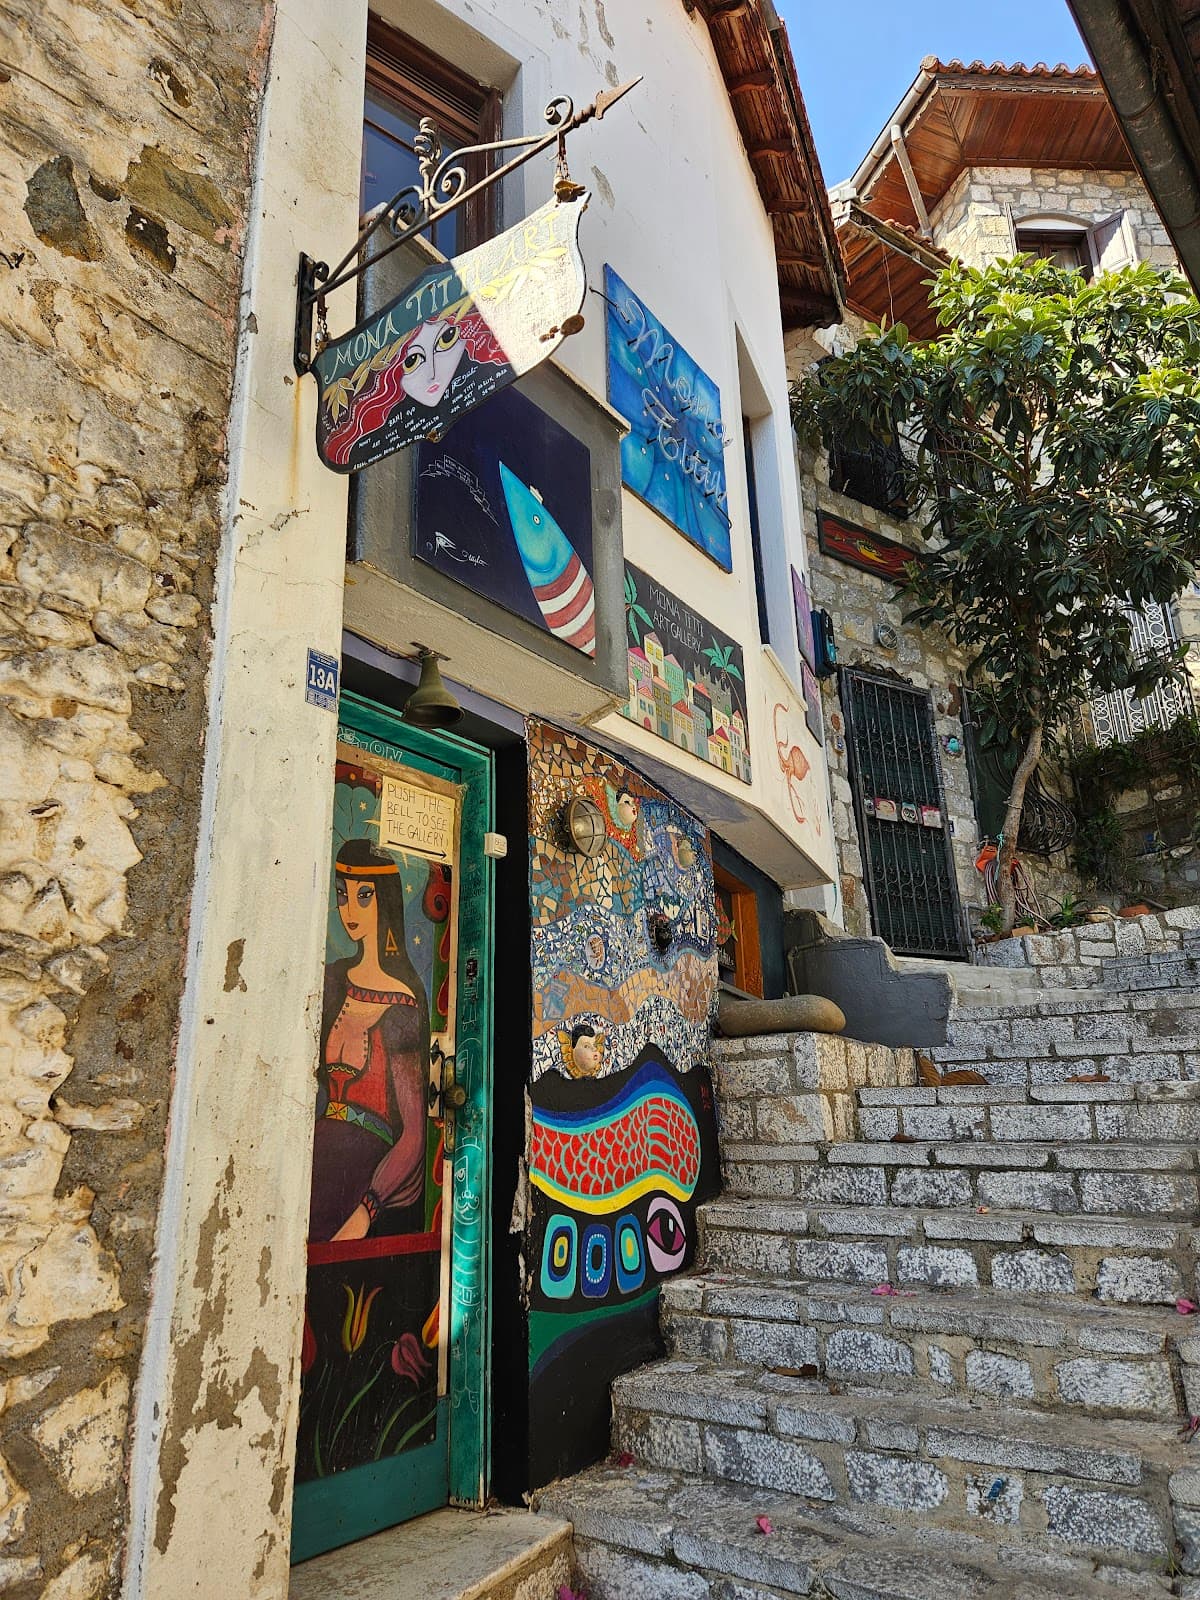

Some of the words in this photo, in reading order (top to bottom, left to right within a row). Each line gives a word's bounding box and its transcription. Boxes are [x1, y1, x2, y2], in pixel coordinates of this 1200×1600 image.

[325, 313, 399, 384] MONA
[493, 210, 560, 276] ART
[649, 585, 681, 620] MONA
[682, 608, 704, 638] TITTI
[653, 609, 671, 633] ART
[671, 622, 701, 655] GALLERY
[309, 663, 335, 695] 13A
[387, 783, 416, 804] PUSH
[386, 819, 406, 837] THE
[387, 801, 414, 819] BELL
[416, 811, 430, 827] TO
[431, 815, 448, 832] SEE
